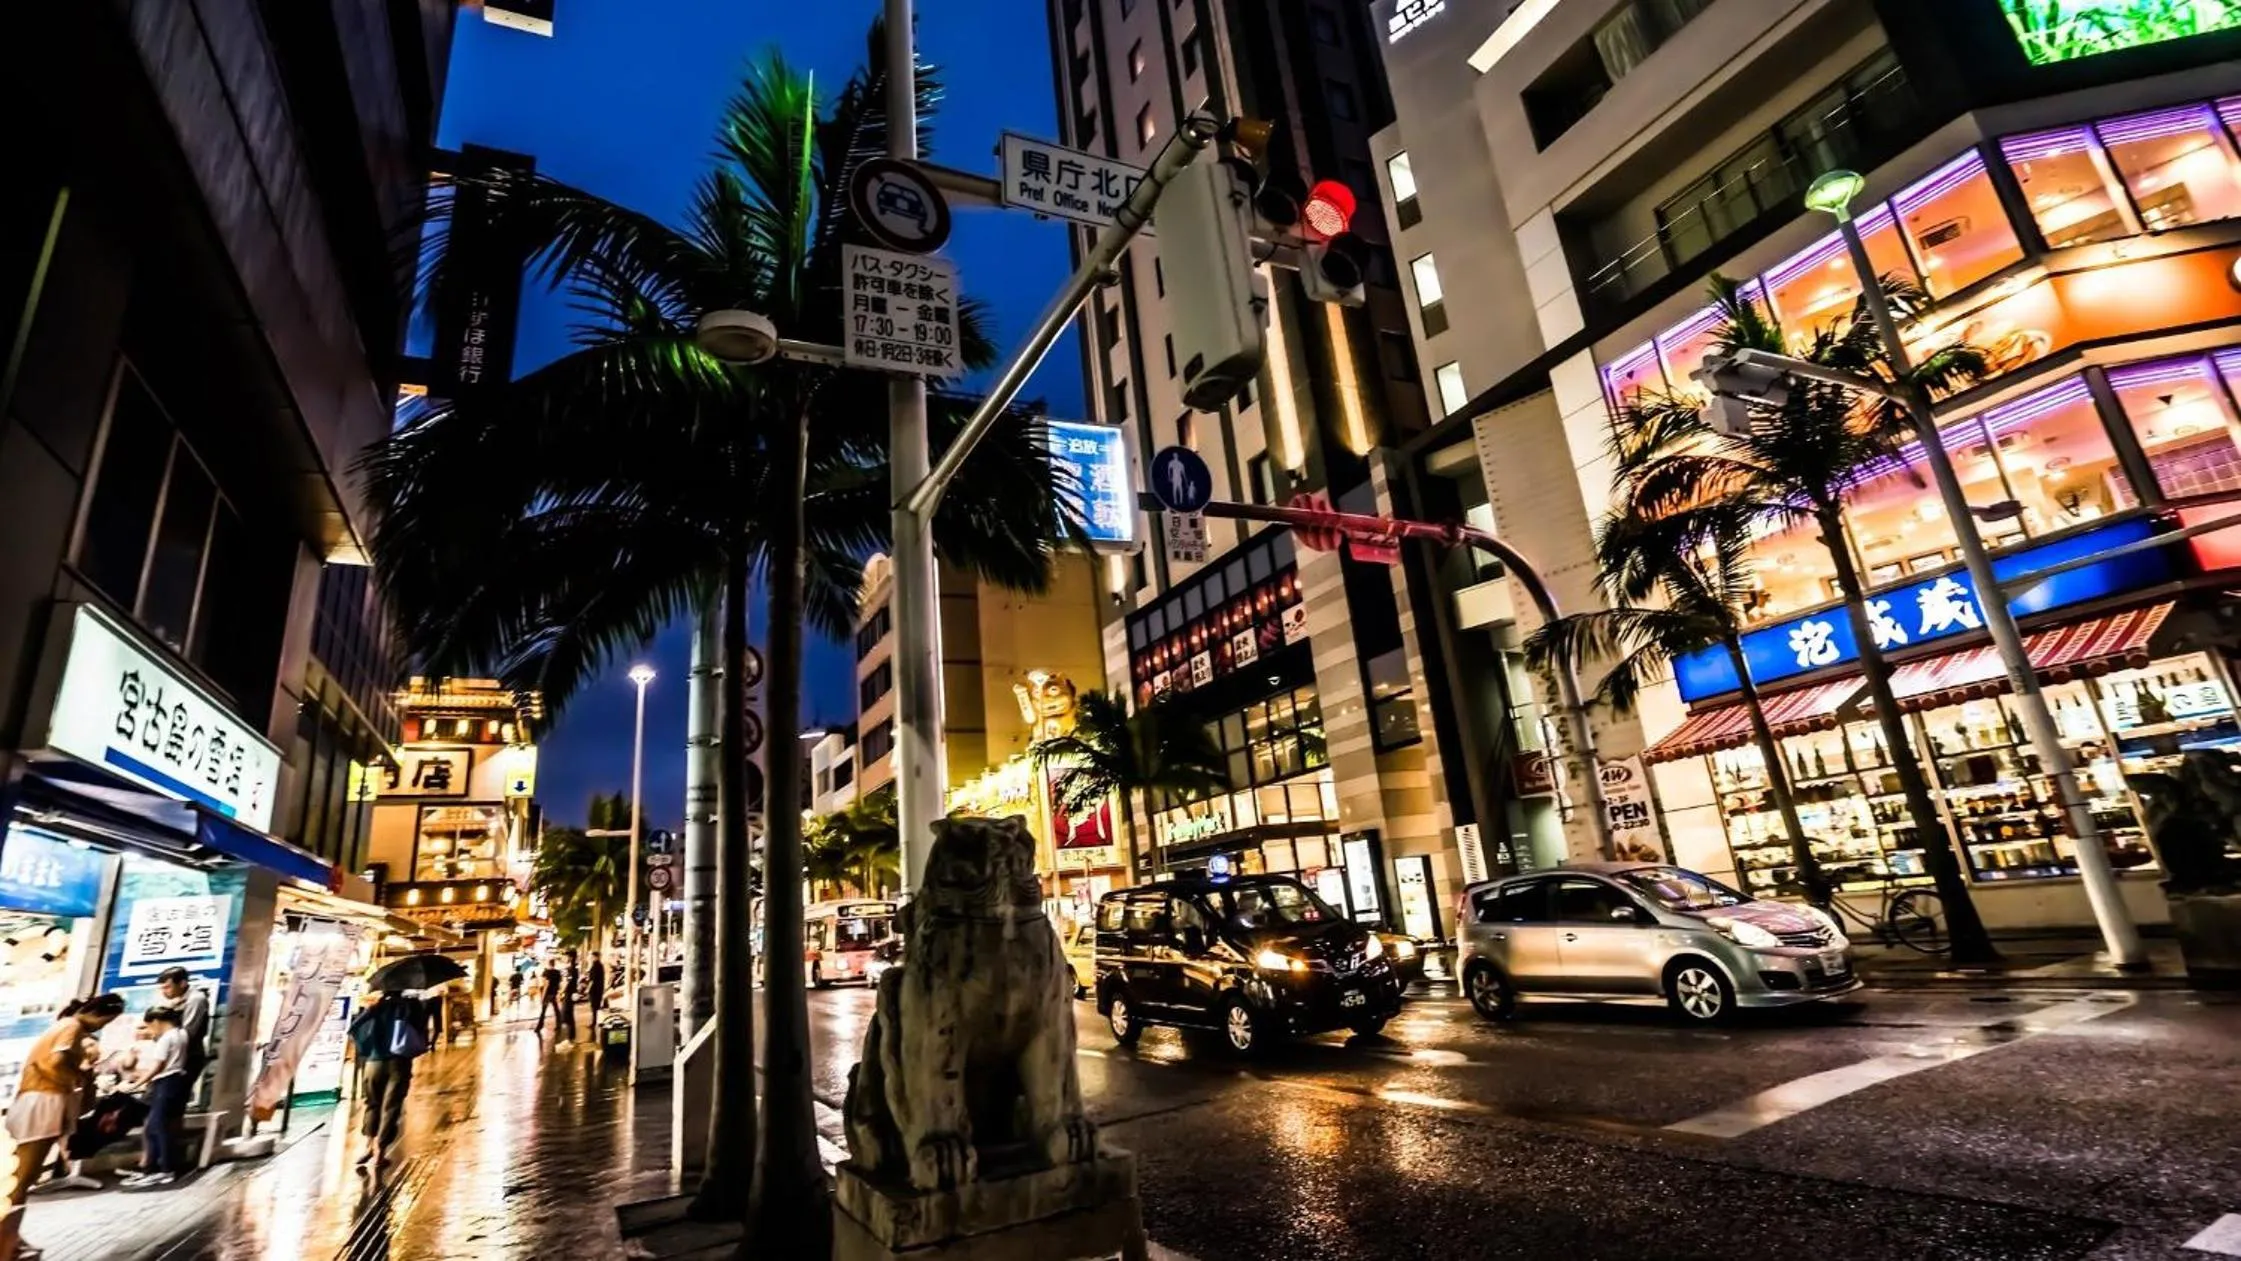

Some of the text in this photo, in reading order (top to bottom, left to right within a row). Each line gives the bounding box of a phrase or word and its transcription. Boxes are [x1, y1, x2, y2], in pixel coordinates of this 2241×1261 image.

[1054, 189, 1089, 213] Office
[853, 273, 950, 304] 許可車を除く
[854, 314, 894, 337] 17:30
[914, 323, 952, 345] 19:00
[116, 669, 246, 796] 宮古島の雪塩
[1608, 800, 1649, 822] PEN
